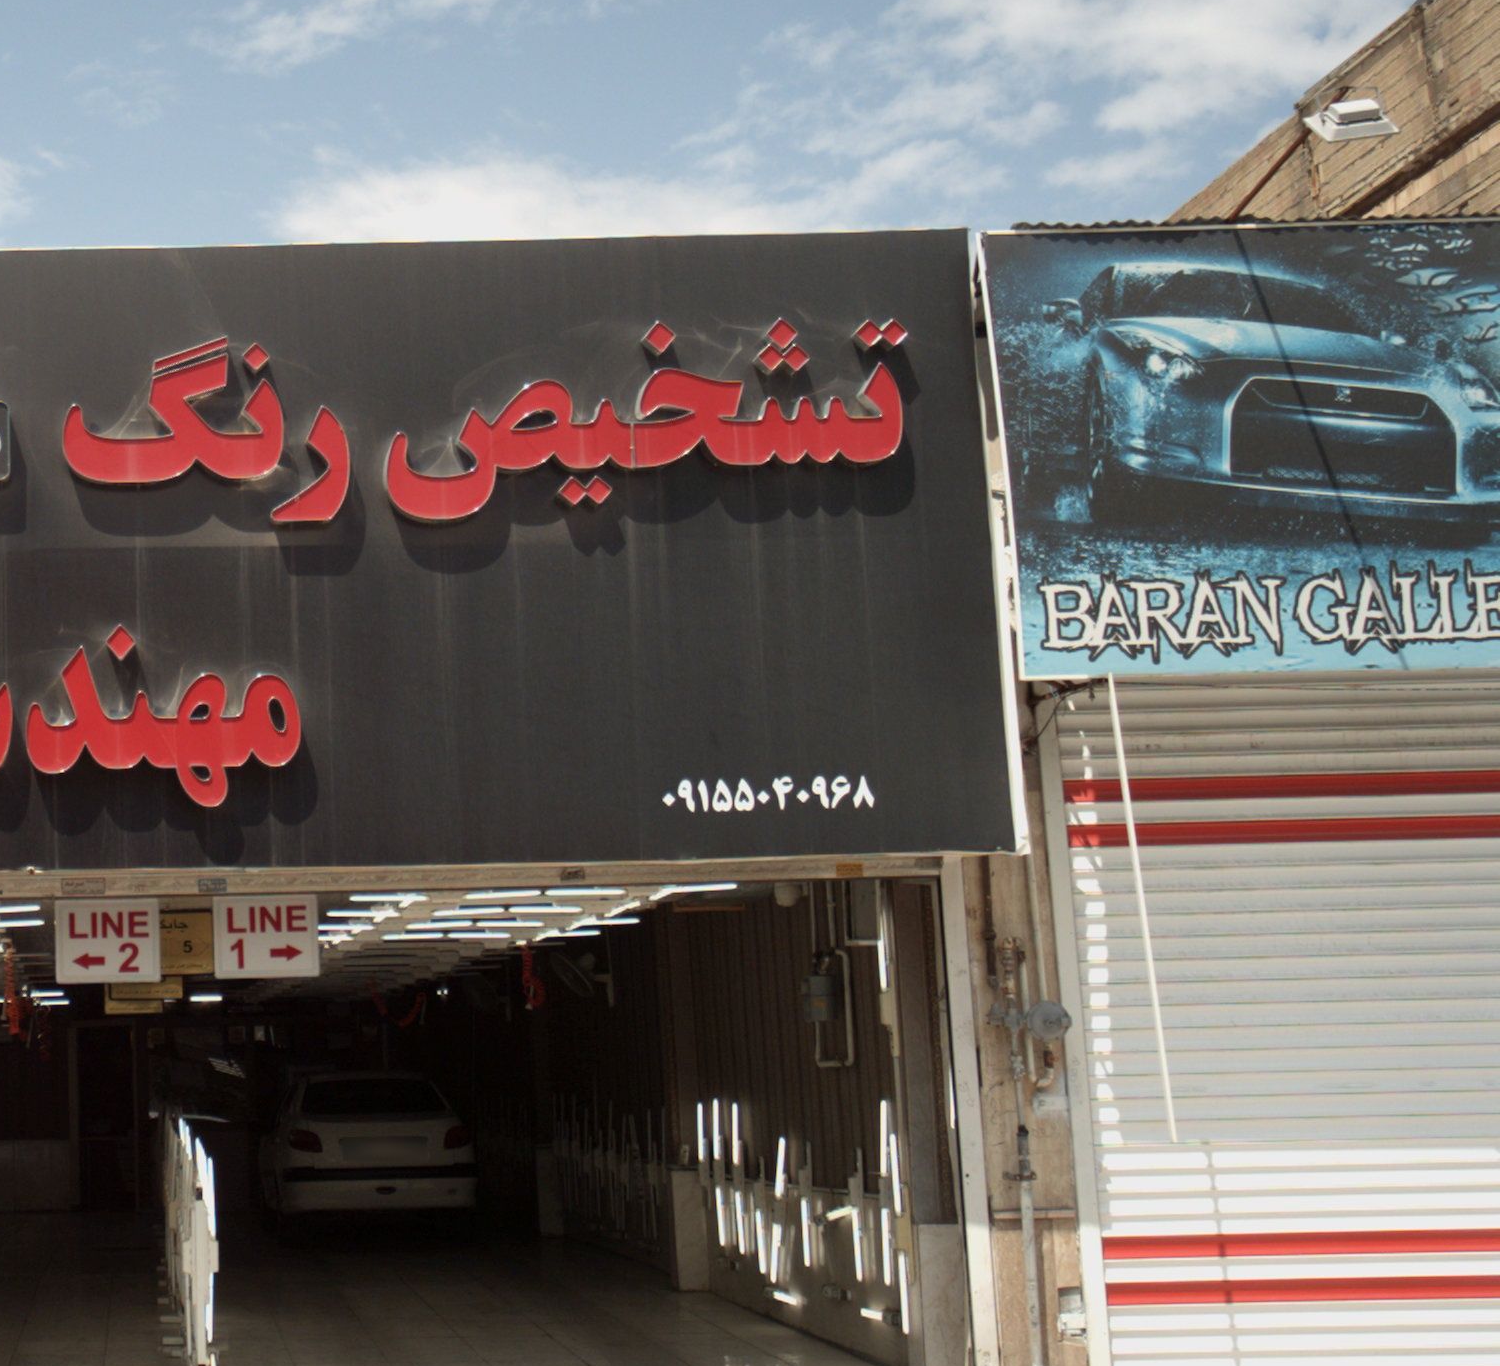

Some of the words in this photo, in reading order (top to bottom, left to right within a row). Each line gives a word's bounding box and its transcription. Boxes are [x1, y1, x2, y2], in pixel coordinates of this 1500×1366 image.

[60, 334, 351, 525] رنگ
[385, 316, 908, 524] تشخیص
[1037, 568, 1287, 665] BARAN
[661, 775, 876, 814] ۰۹۱۵۵۰۴۰۹۶۸
[68, 910, 150, 940] LINE
[226, 905, 308, 934] LINE
[118, 941, 141, 973] 2
[183, 940, 193, 954] 5
[230, 938, 245, 969] 1
